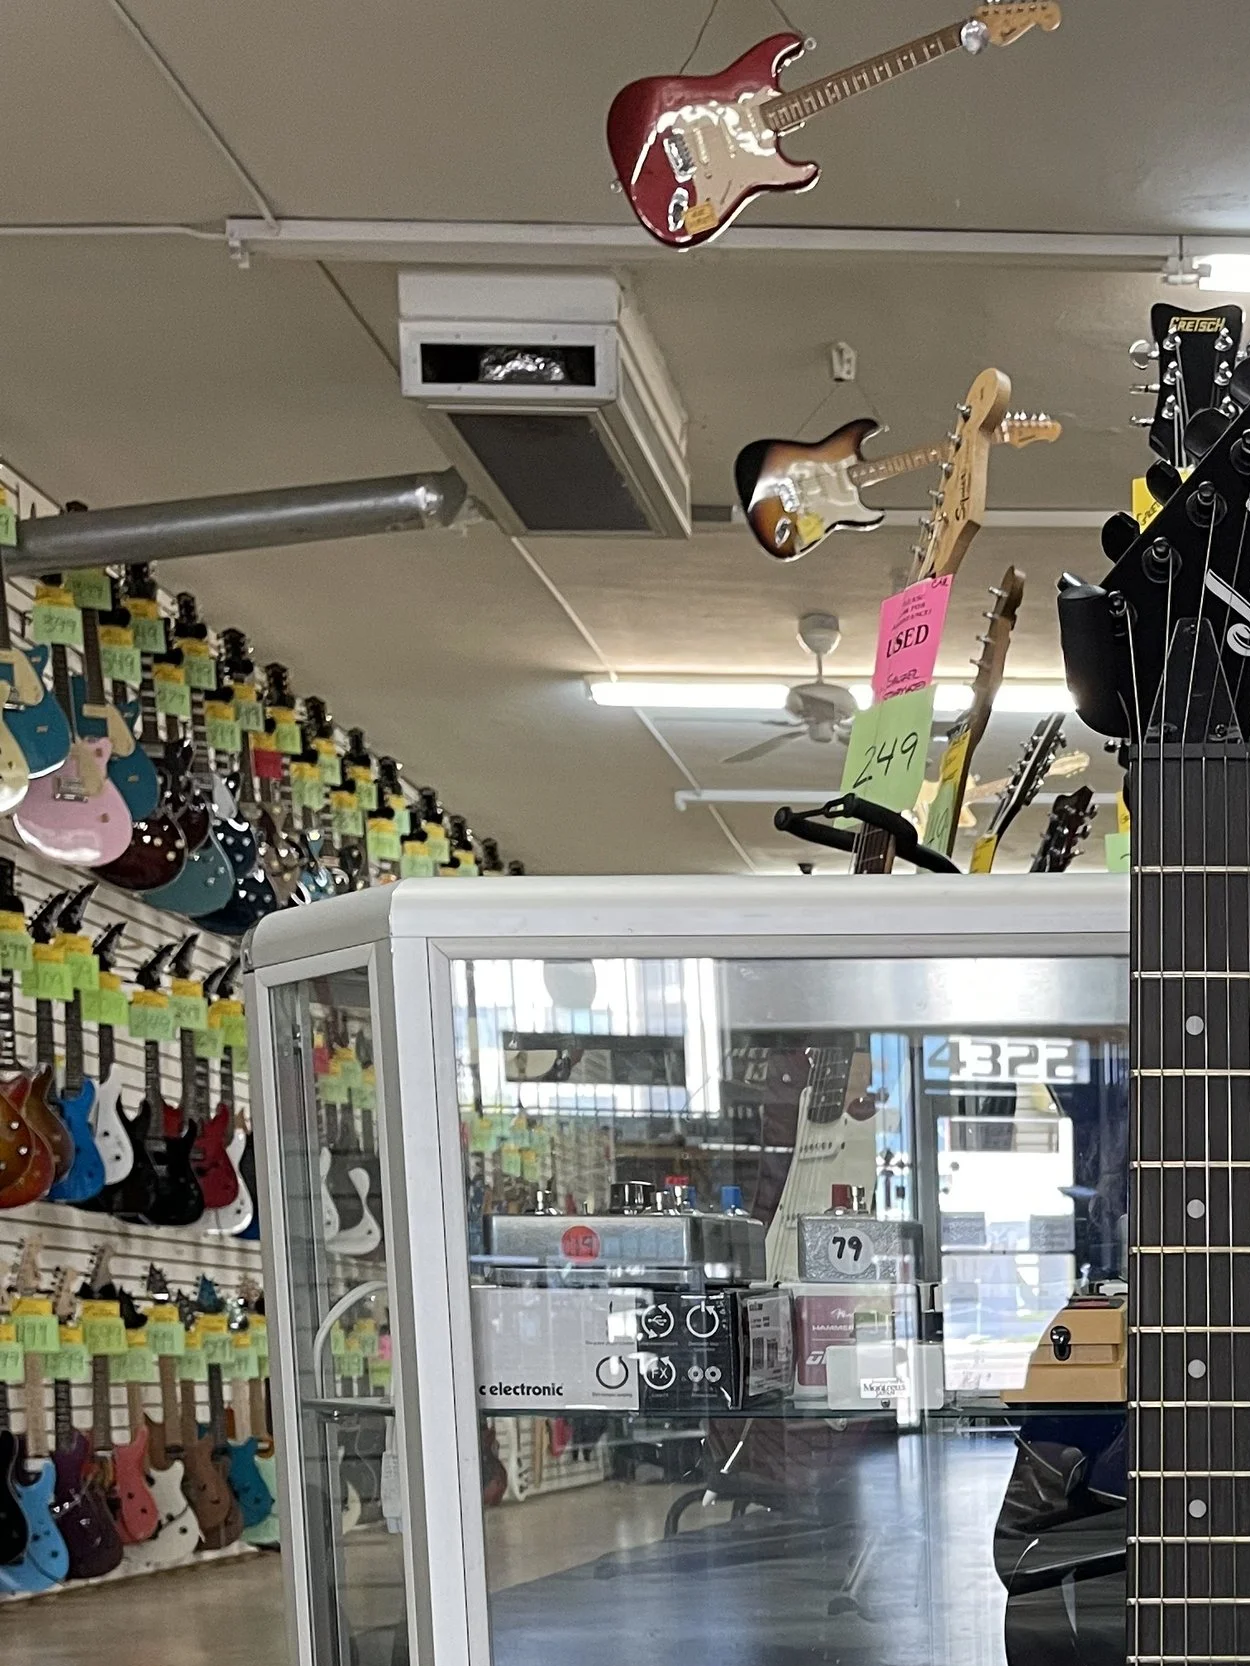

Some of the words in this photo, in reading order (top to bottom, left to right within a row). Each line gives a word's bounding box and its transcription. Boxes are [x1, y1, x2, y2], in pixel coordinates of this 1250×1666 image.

[1168, 316, 1227, 332] GRETSCH
[1136, 501, 1160, 526] GRE
[853, 732, 919, 788] 249
[928, 1041, 1077, 1081] 4322
[832, 1236, 863, 1261] 79
[812, 1324, 855, 1332] HAMMER
[651, 1367, 668, 1379] FX
[490, 1382, 563, 1397] electronic
